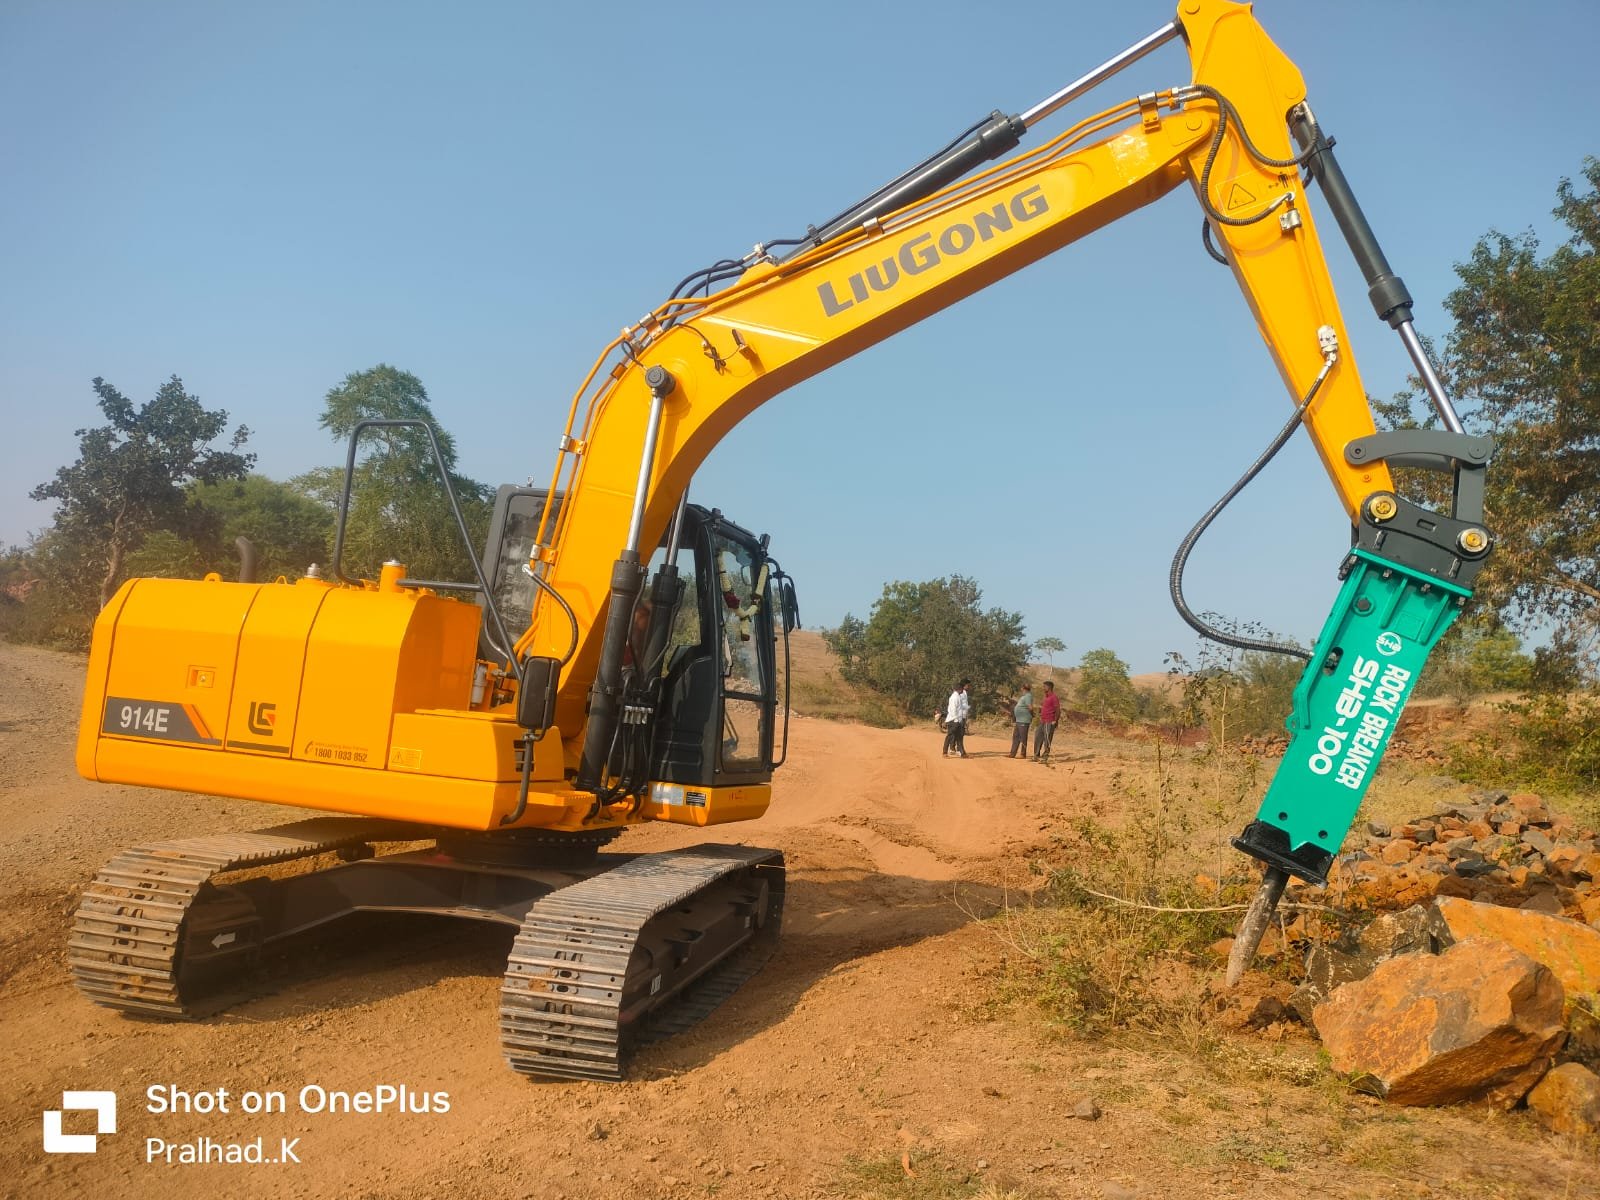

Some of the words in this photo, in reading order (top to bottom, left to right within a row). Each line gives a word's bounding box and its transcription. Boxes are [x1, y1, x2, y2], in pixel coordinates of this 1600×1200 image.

[817, 184, 1049, 317] LIUGONG
[120, 705, 170, 733] 914E
[1308, 655, 1379, 775] SHB-100
[1369, 664, 1411, 714] ROCK
[315, 747, 332, 758] 1800
[334, 750, 352, 761] 1033
[1335, 712, 1389, 789] BREAKER
